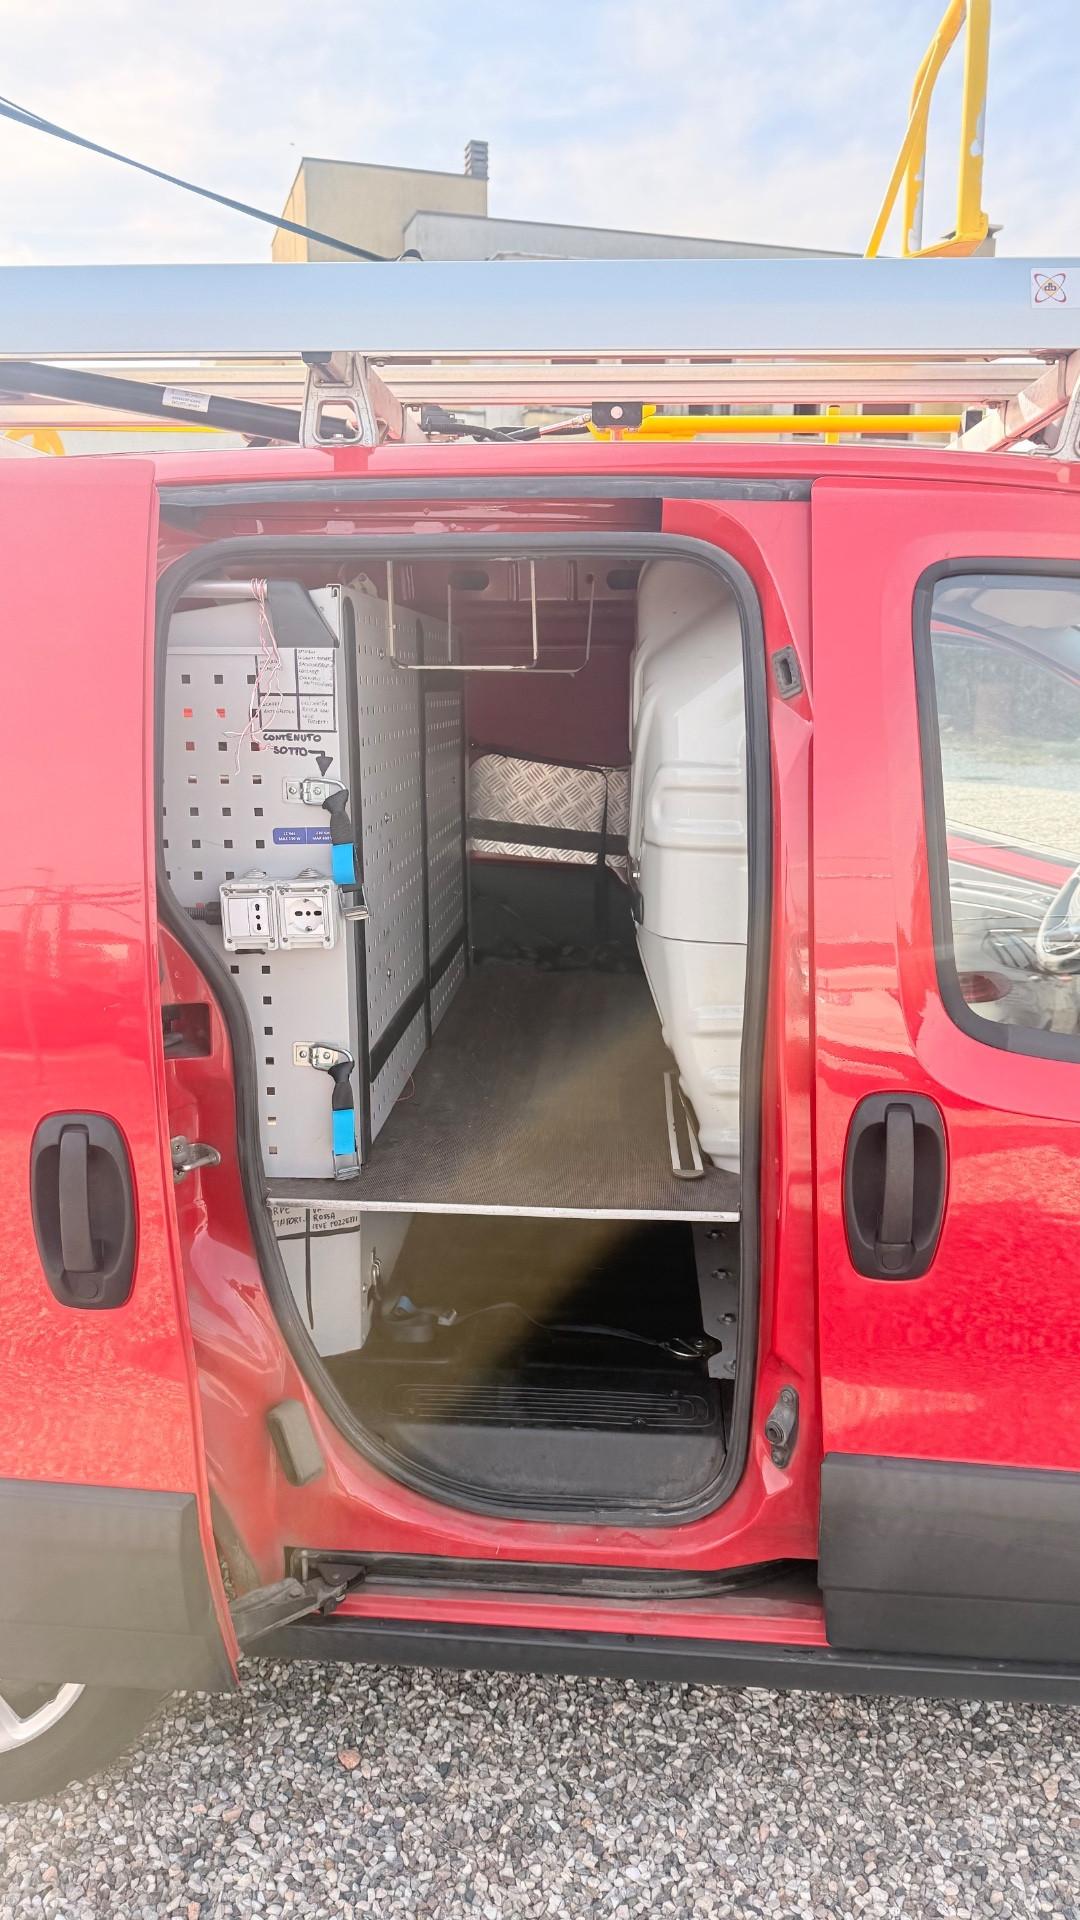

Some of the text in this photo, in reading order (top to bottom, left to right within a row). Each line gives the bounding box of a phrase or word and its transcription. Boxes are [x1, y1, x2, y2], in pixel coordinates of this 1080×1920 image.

[263, 733, 322, 742] CONTENUTO
[273, 746, 308, 756] SOTTO
[312, 1212, 336, 1221] ROSSA
